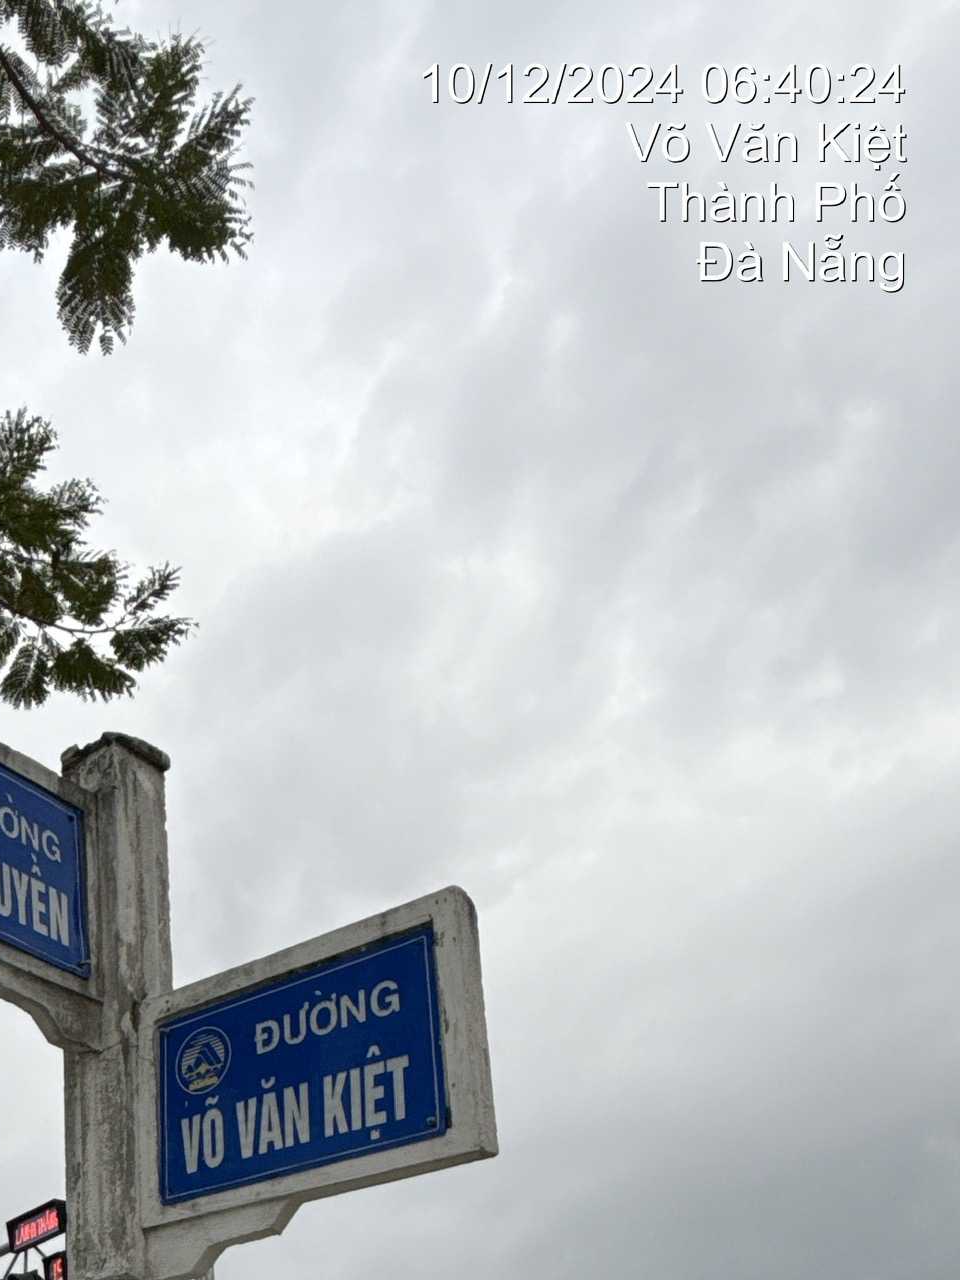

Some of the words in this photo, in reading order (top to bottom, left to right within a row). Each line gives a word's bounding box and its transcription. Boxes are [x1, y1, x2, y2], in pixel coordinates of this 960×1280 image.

[254, 980, 401, 1055] ĐƯỜNG
[180, 1096, 225, 1174] VÕ
[236, 1076, 311, 1160] VĂN
[323, 1045, 410, 1140] KIỆT
